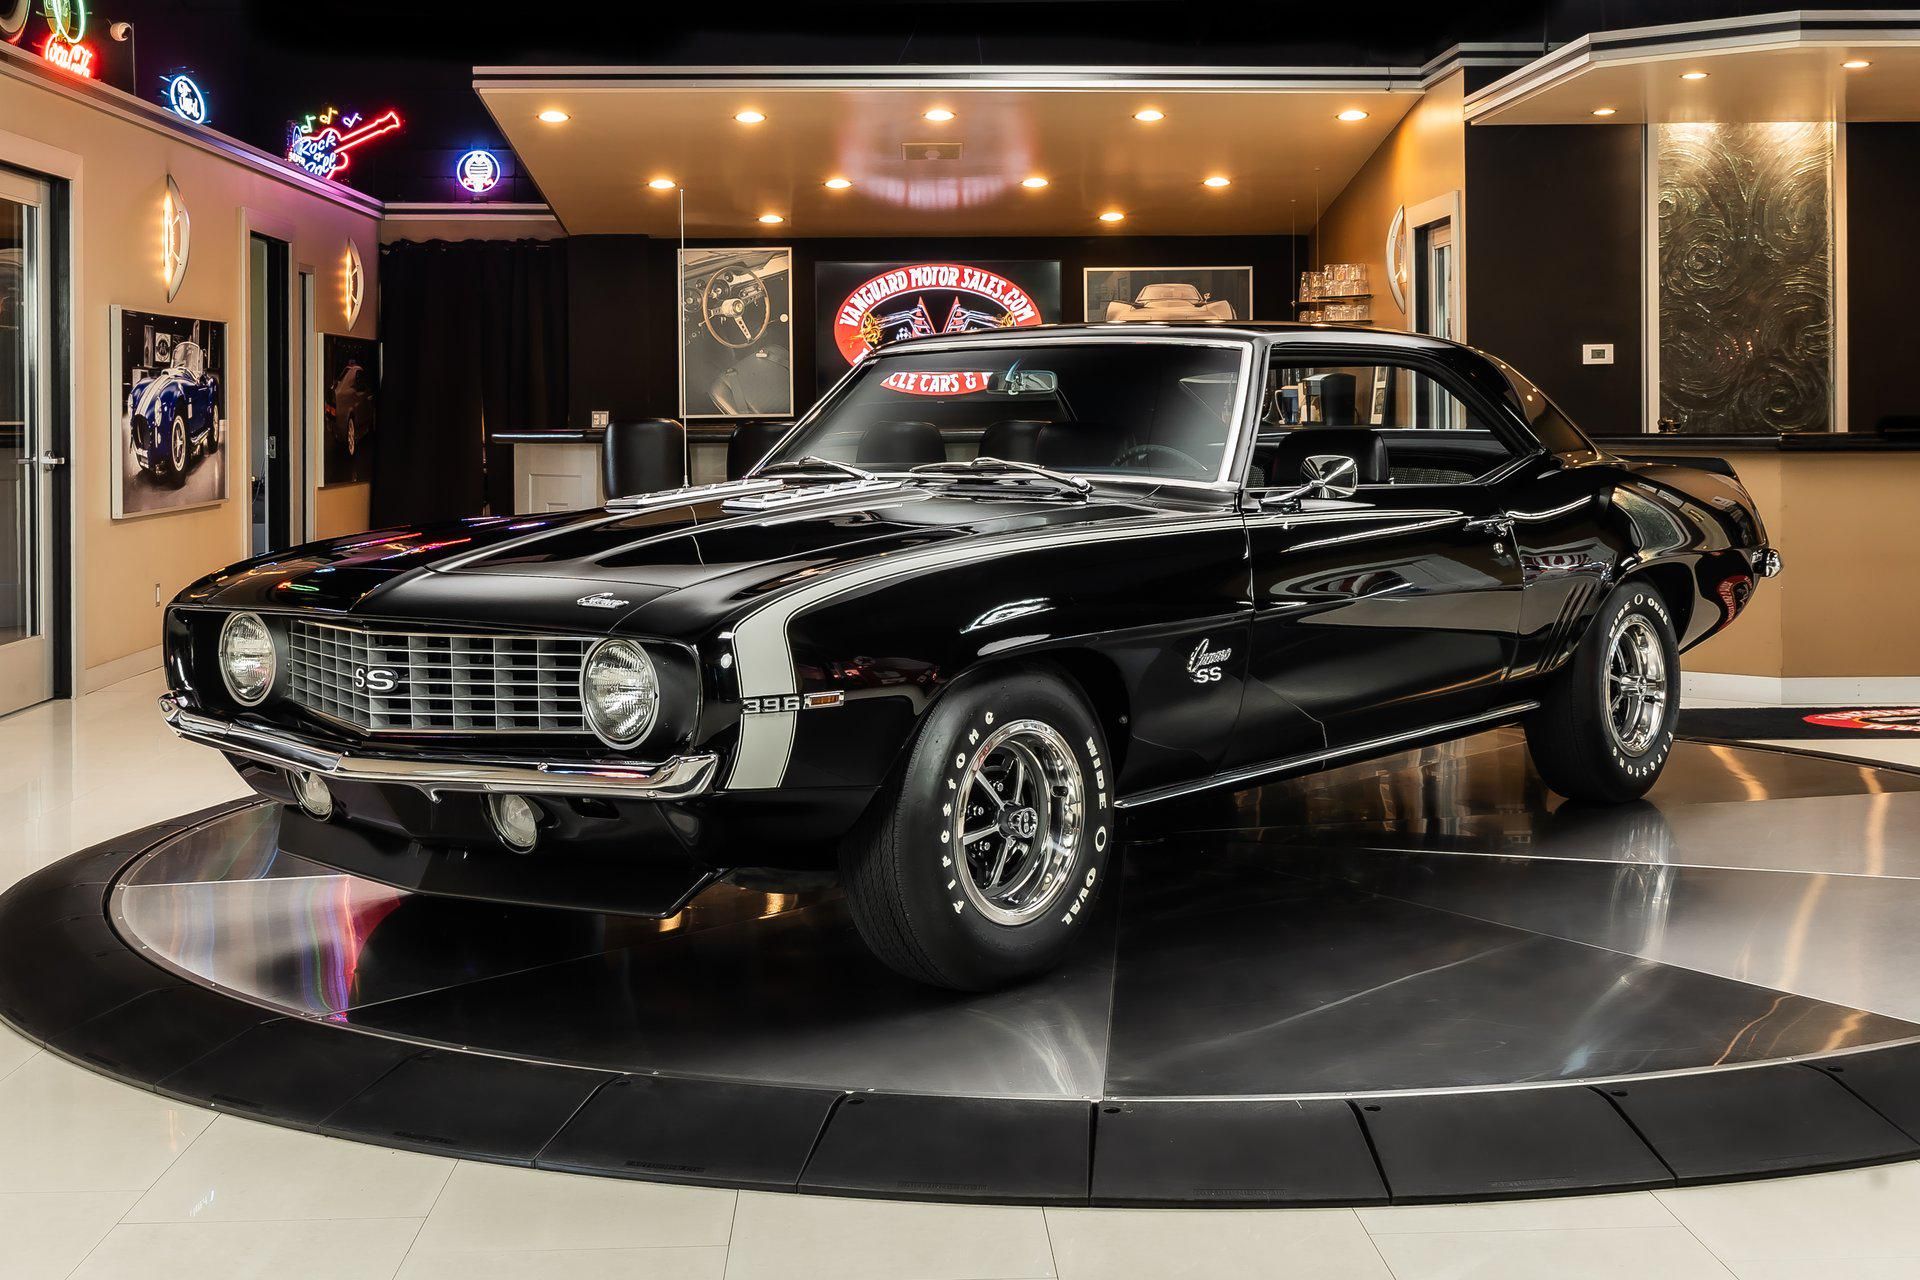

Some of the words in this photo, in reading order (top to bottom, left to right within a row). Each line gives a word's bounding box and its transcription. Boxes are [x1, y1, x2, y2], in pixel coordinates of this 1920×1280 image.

[298, 129, 337, 156] Rock
[839, 269, 908, 327] VANGUARD
[909, 265, 960, 288] MOTOR
[919, 373, 960, 393] CARS
[355, 668, 395, 690] SS
[1193, 666, 1222, 684] SS
[742, 695, 800, 714] 396
[1085, 736, 1107, 810] WIDE
[1061, 867, 1097, 925] OVAL
